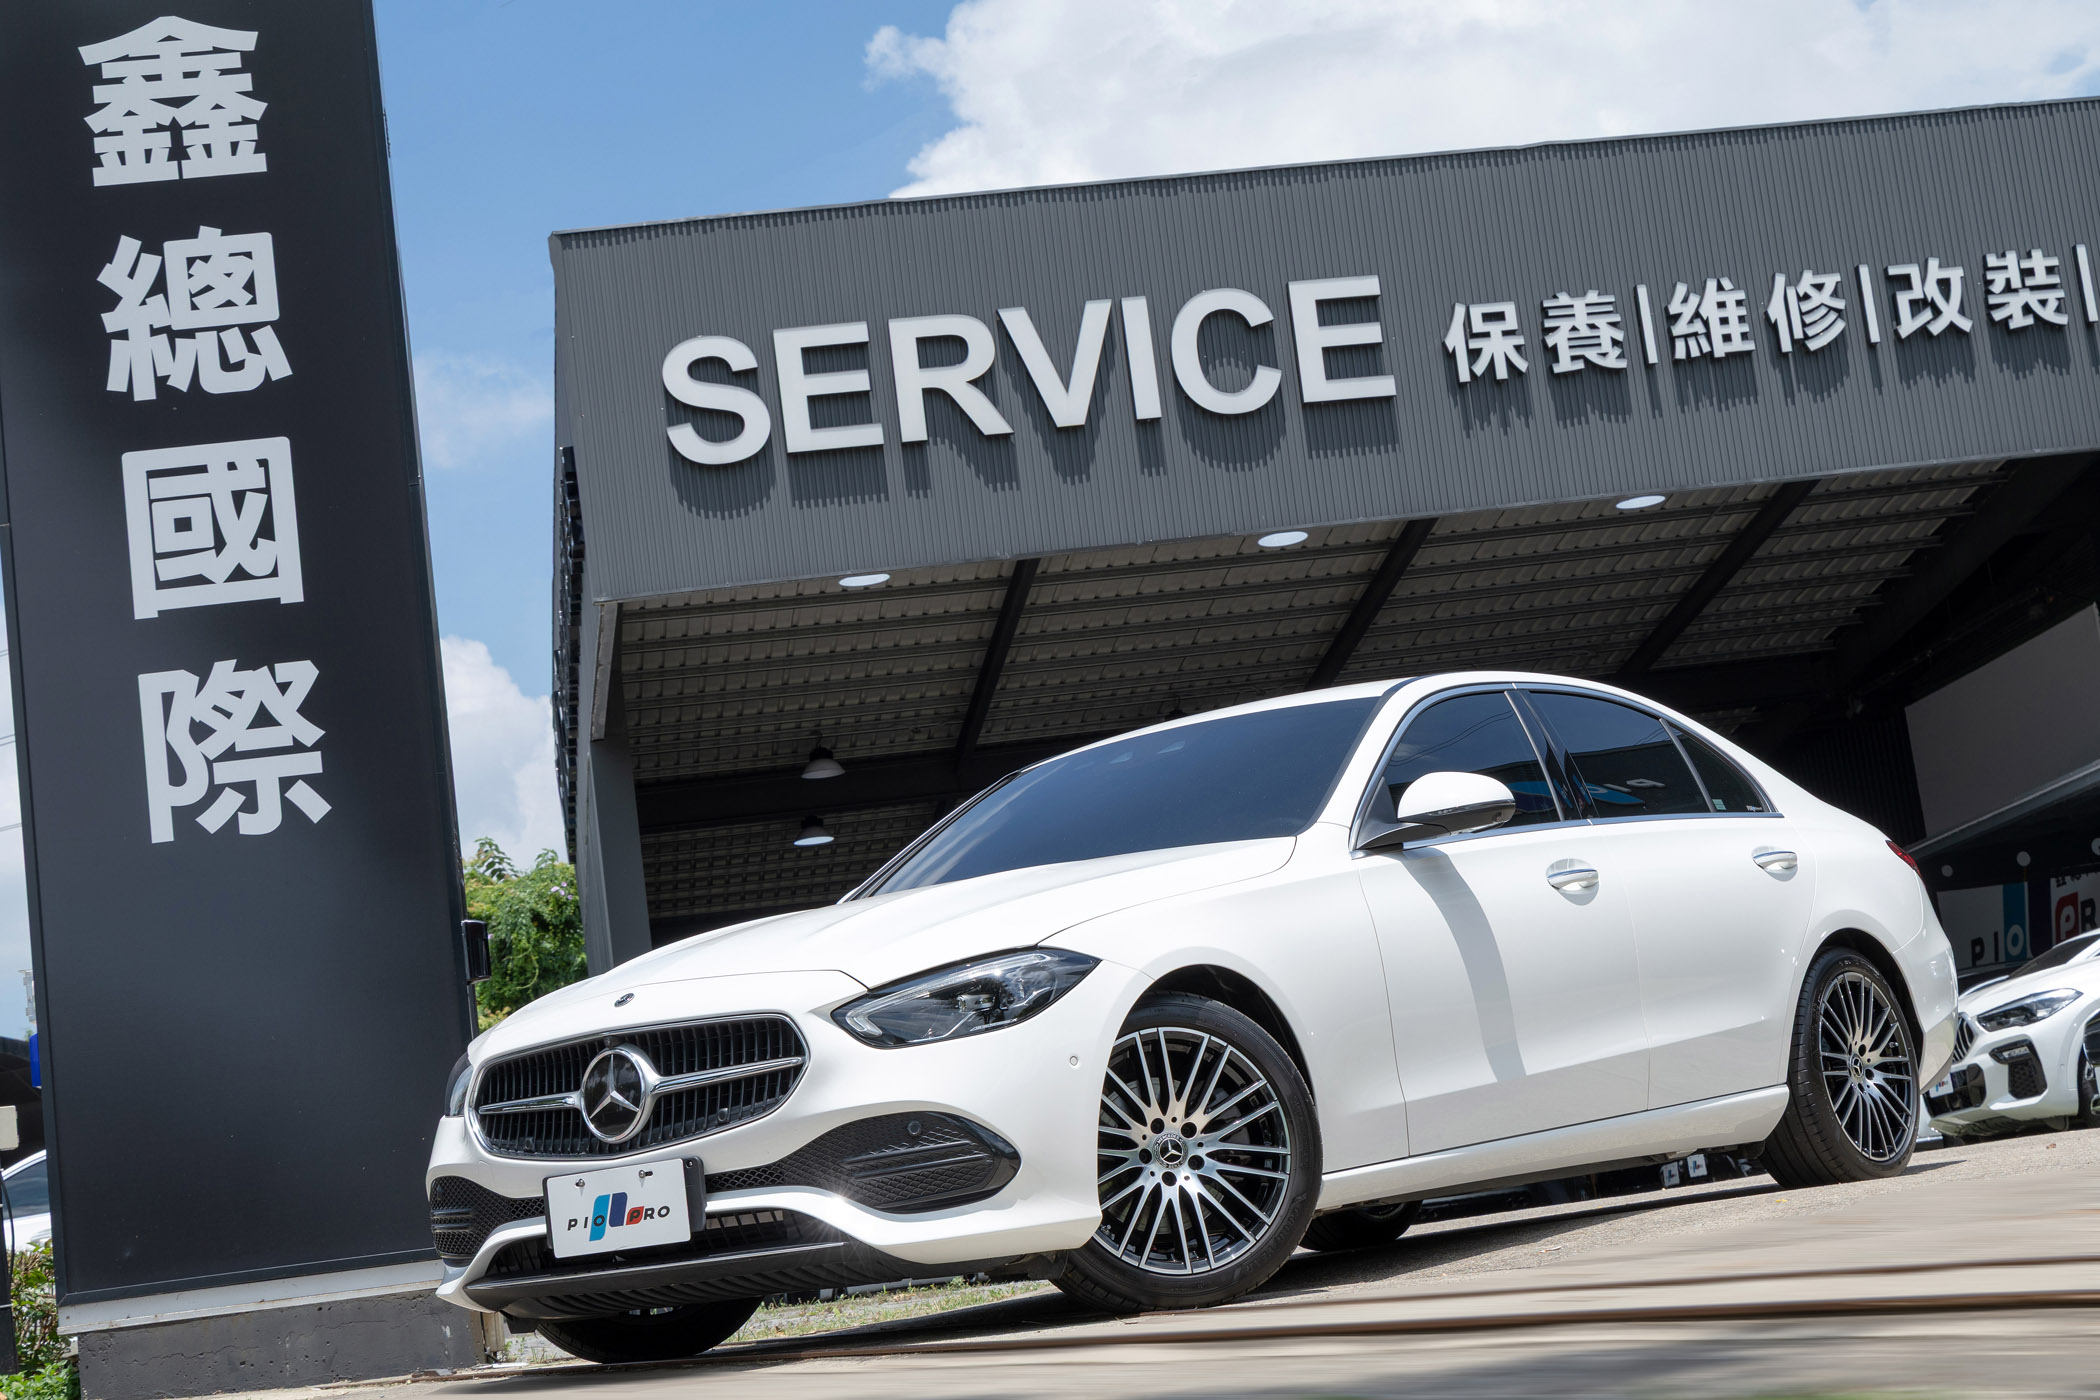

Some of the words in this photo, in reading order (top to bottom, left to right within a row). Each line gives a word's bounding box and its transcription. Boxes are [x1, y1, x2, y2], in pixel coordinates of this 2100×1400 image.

[78, 15, 332, 843] 鑫總國際
[661, 274, 1397, 465] SERVICE
[1970, 924, 2025, 967] PIO
